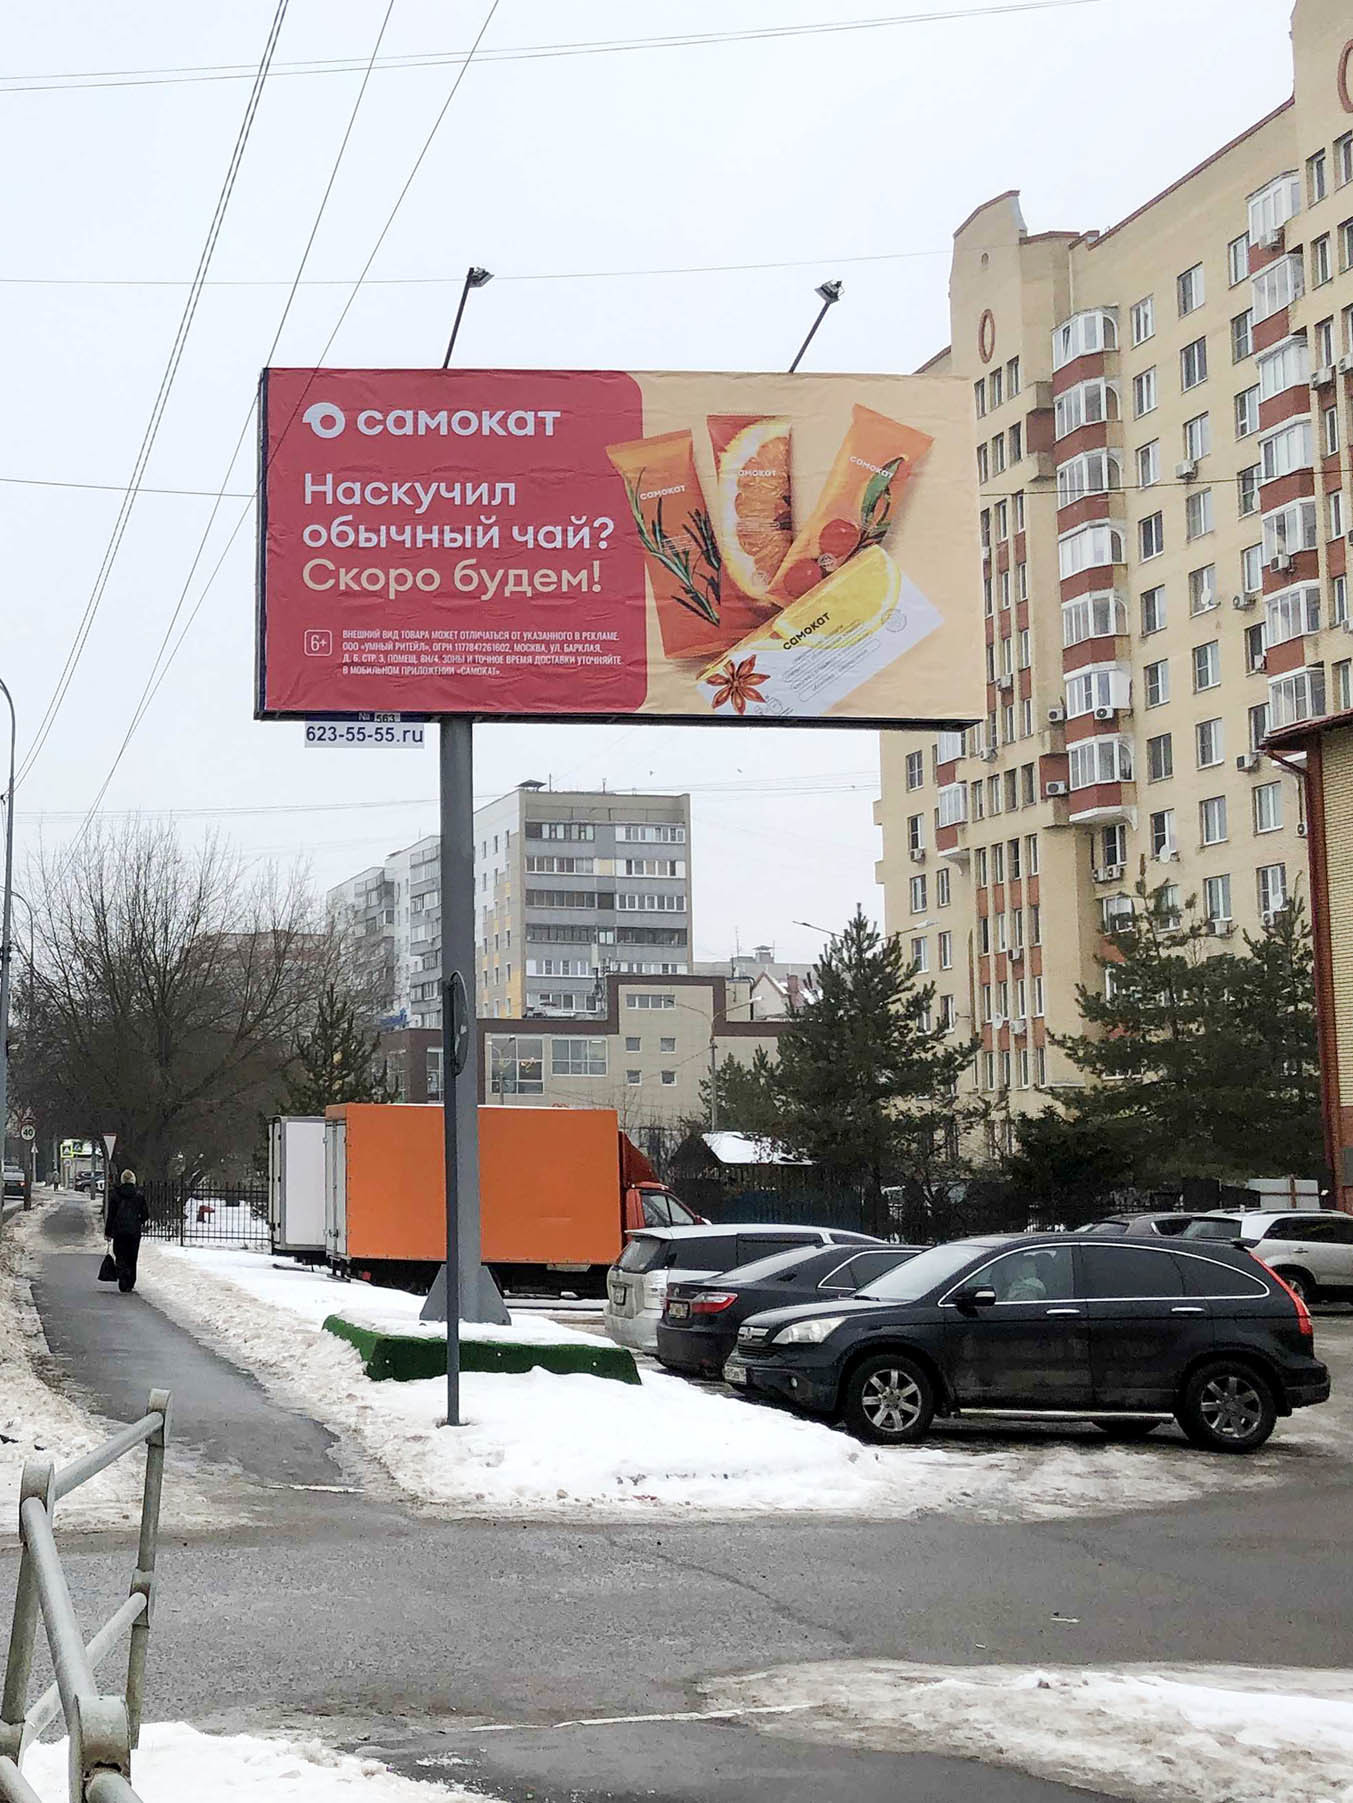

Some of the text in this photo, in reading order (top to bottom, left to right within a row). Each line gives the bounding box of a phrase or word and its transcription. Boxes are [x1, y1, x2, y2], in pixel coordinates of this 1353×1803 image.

[356, 409, 561, 436] самокат
[304, 473, 516, 514] Наскучил
[302, 514, 615, 550] обычный чай?
[302, 558, 602, 601] Скоро будем!
[342, 629, 381, 639] ВНЕШНИЙ
[382, 630, 399, 640] ВИД
[401, 630, 430, 640] ТОВАРА
[431, 631, 458, 640] МОЖЕТ
[459, 631, 510, 640] ОТЛИЧАТЬСЯ
[511, 631, 521, 640] ОТ
[523, 631, 573, 641] УКАЗАННОГО
[574, 632, 581, 641] В
[782, 612, 832, 650] самокат
[310, 634, 327, 652] 6+
[342, 642, 359, 651] ООО
[433, 643, 453, 652] ОГРН
[474, 655, 504, 664] ТОЧНОЕ
[505, 655, 532, 664] ВРЕМЯ
[534, 655, 576, 665] ДОСТАВКИ
[342, 666, 347, 675] В
[350, 666, 399, 675] МОБИЛЬНОМ
[401, 667, 455, 676] ПРИЛОЖЕНИИ
[306, 726, 424, 743] 623-55-55.ru
[23, 1128, 34, 1136] 40
